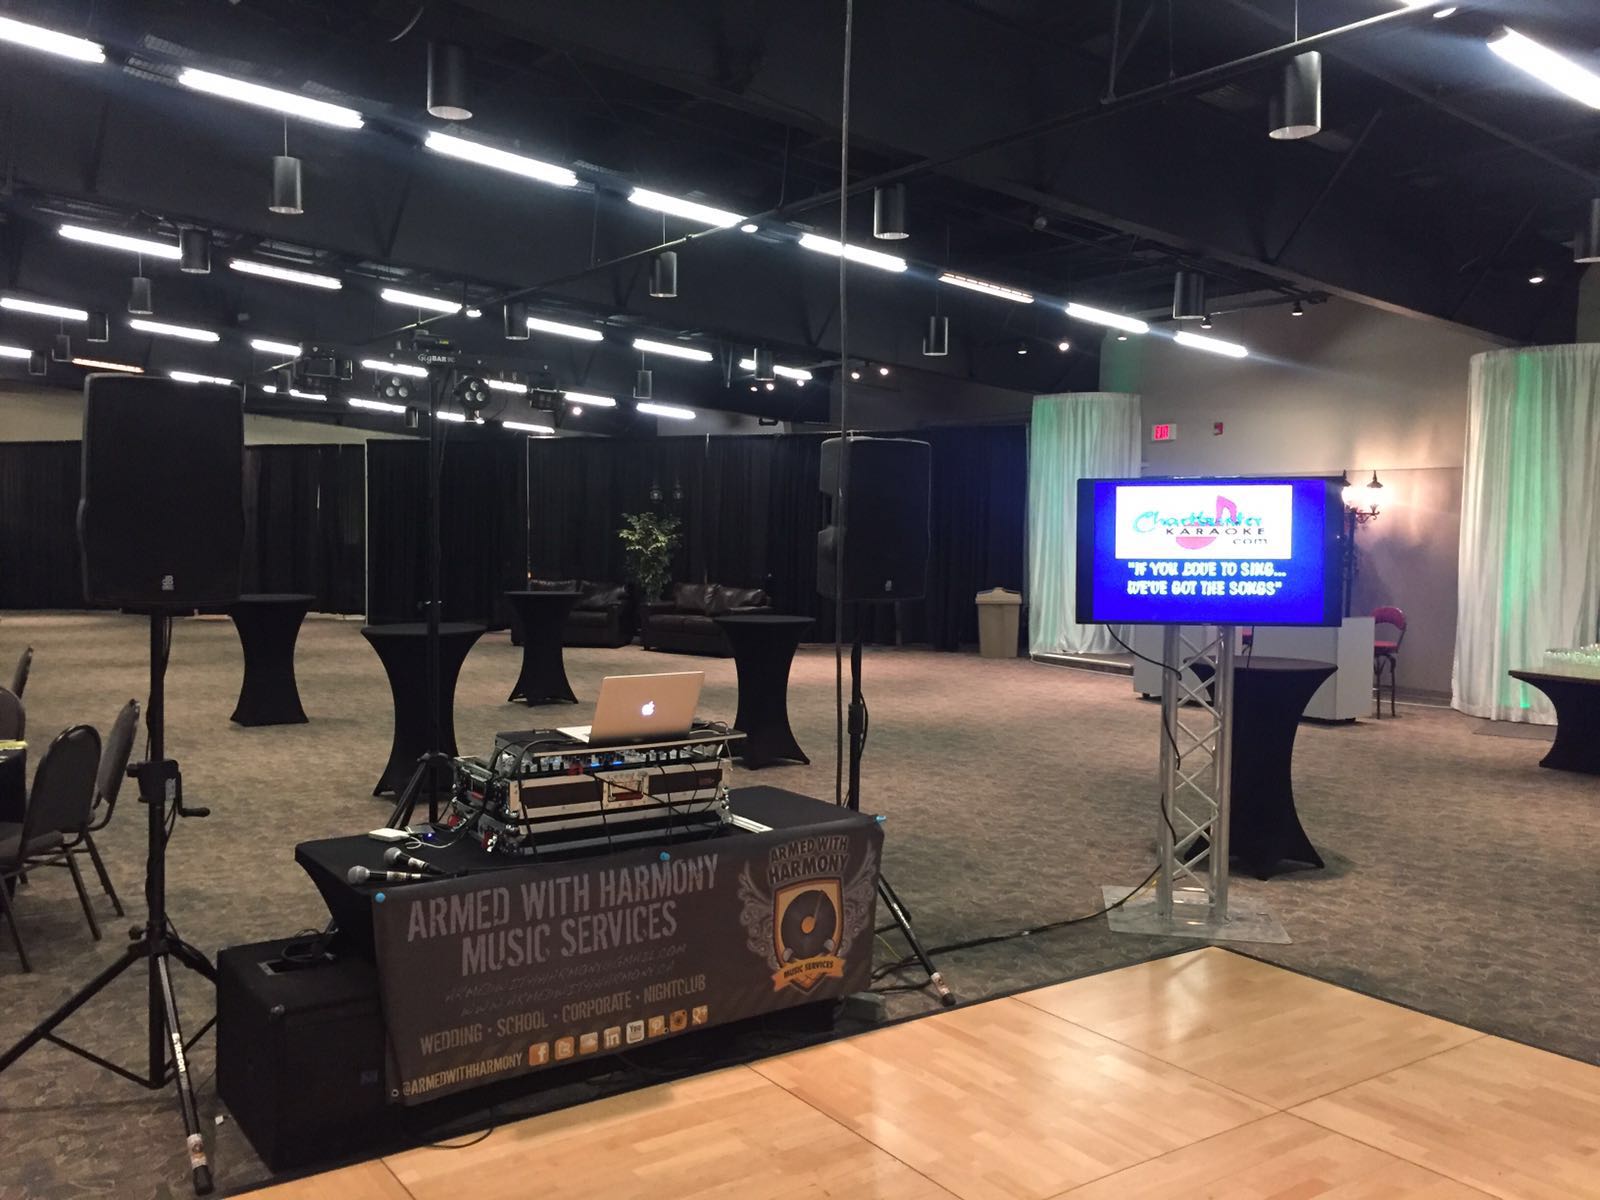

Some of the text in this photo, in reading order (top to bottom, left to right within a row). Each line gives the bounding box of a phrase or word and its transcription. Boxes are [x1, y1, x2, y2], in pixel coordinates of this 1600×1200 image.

[1150, 562, 1179, 577] YOU
[1182, 562, 1217, 577] LOVE
[1220, 562, 1238, 577] TO
[1127, 580, 1168, 595] WE'VE
[1172, 581, 1198, 595] GOT
[1201, 581, 1226, 596] THE
[771, 836, 848, 863] ARMED WITH
[768, 855, 849, 885] HARMONY
[408, 855, 719, 942] ARMED WITH HARMONY
[462, 902, 678, 977] MUSIC SERVICES
[784, 961, 834, 979] MUSIC SERVICES
[420, 975, 707, 1056] WEDDING SCHOOL CORPORATE NIGHTCLUB
[403, 1053, 525, 1097] @ARMEDWITHHARMONY
